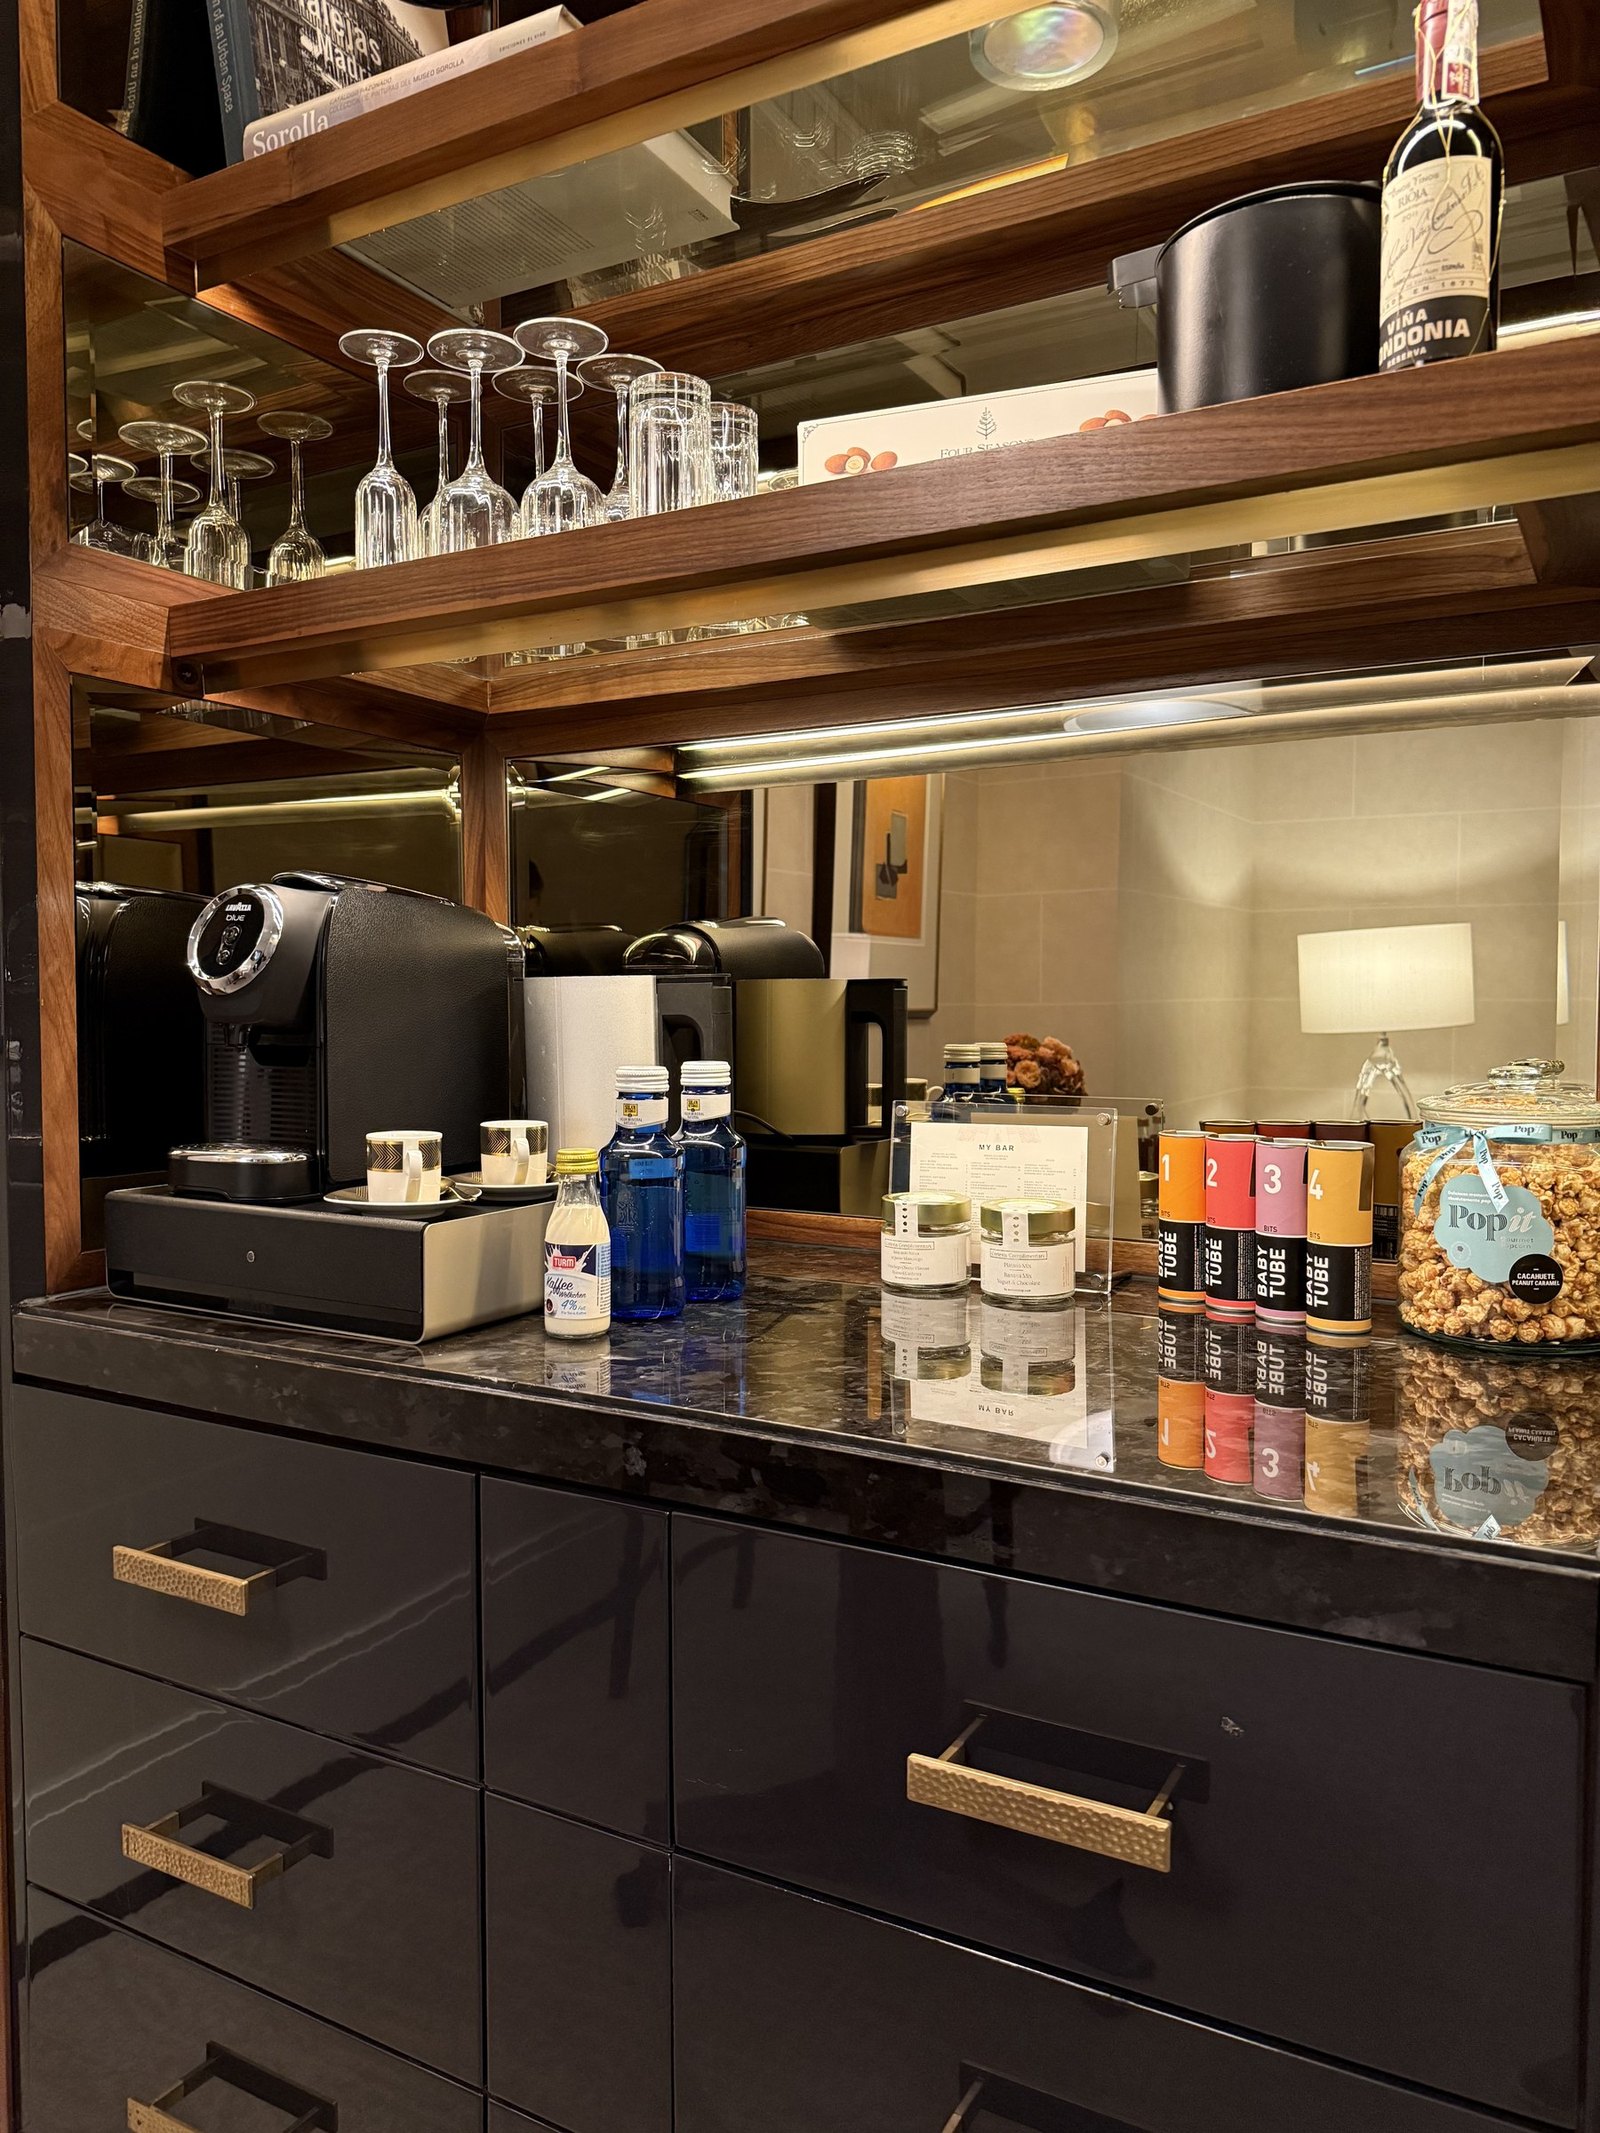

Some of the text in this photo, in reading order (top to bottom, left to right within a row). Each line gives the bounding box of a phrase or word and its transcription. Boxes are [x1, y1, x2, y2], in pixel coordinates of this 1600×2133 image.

[215, 23, 224, 39] an
[217, 38, 229, 75] Urban
[315, 27, 372, 82] Madr
[413, 69, 435, 83] MUSEO
[436, 58, 465, 76] SOROLLA
[221, 75, 233, 113] Space
[252, 109, 329, 158] Sorolla
[1386, 308, 1428, 336] VIÑA
[225, 902, 252, 912] LAVAZZA
[1161, 1154, 1170, 1182] 1
[1206, 1158, 1218, 1188] 2
[1263, 1164, 1282, 1194] 3
[1309, 1168, 1324, 1200] 4
[1263, 1225, 1278, 1233] BITS
[1448, 1204, 1536, 1241] Popit
[554, 1258, 575, 1267] TURM
[1164, 1231, 1177, 1278] TUBE
[1209, 1238, 1222, 1286] TUBE
[546, 1275, 574, 1297] Kaffee
[1257, 1244, 1268, 1297] BABY
[1269, 1247, 1286, 1298] TUBE
[1313, 1256, 1329, 1307] TUBE
[561, 1299, 577, 1311] 4%
